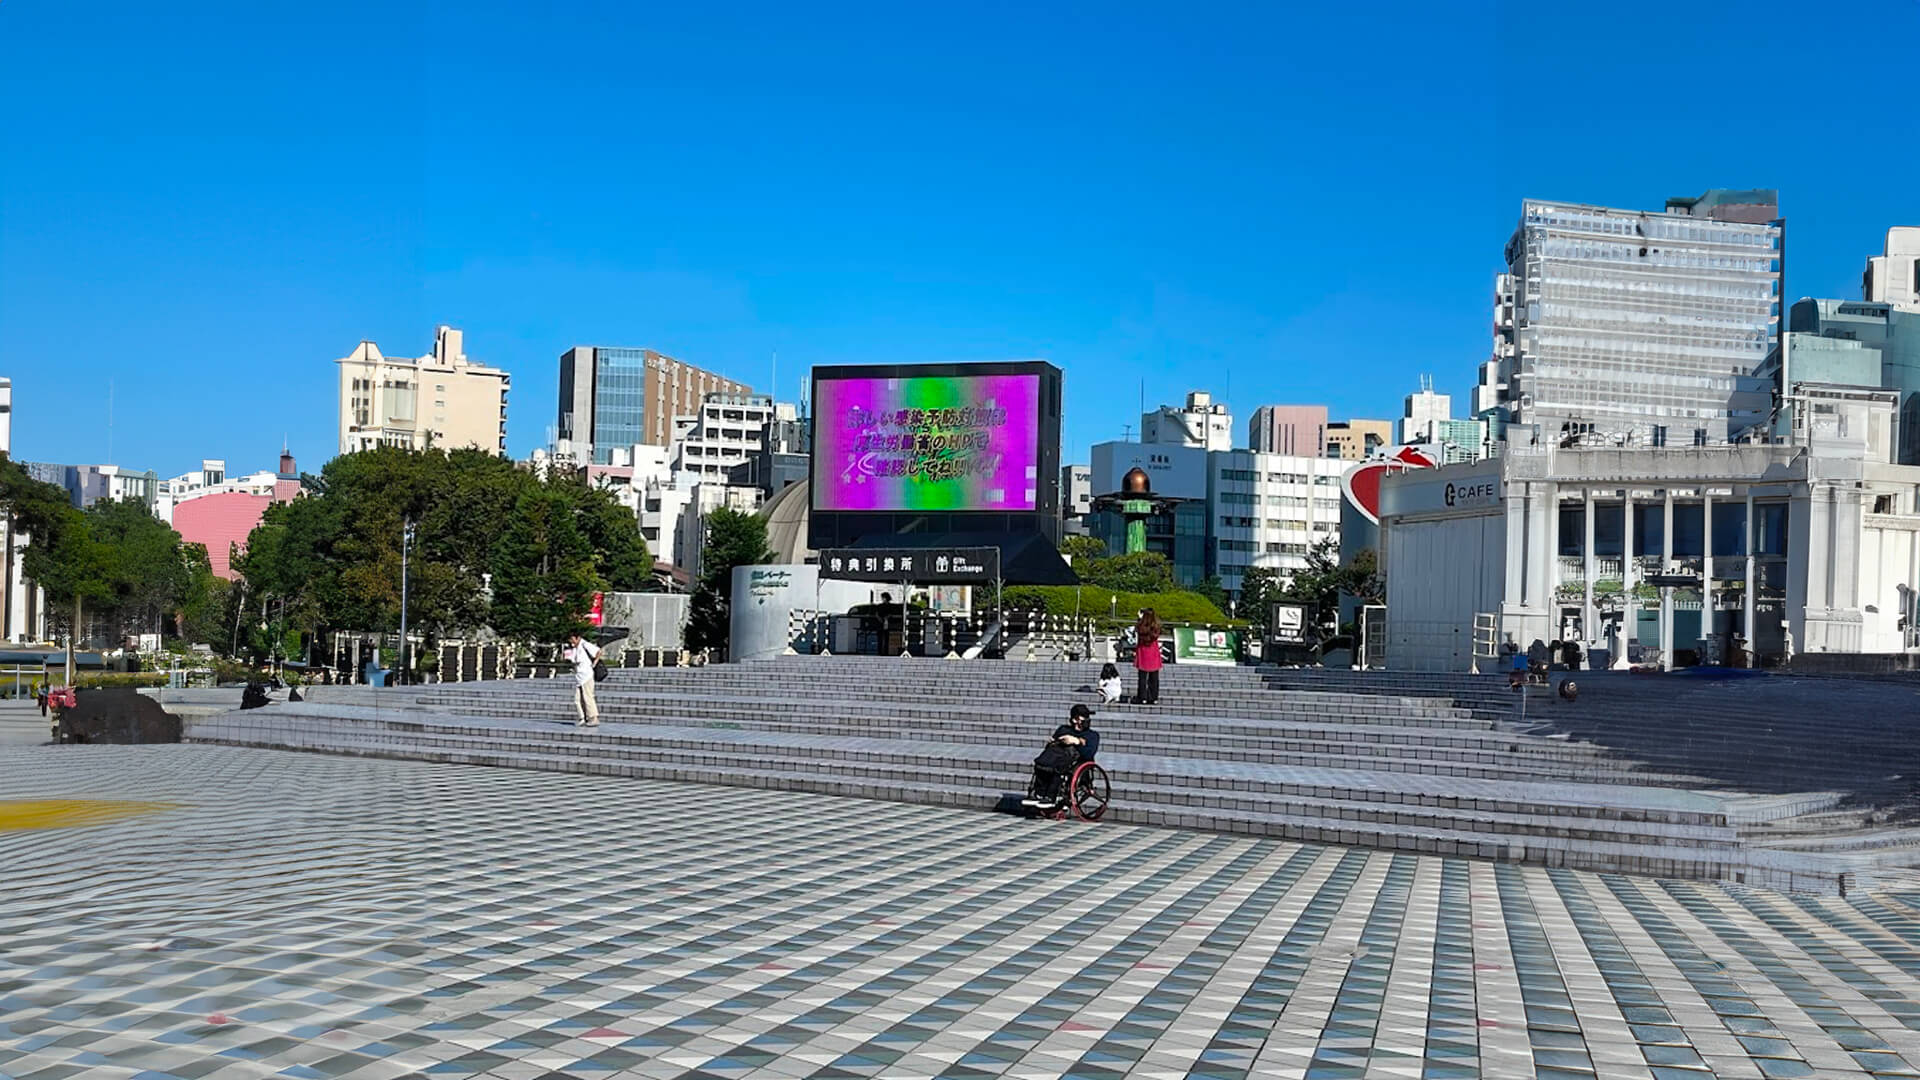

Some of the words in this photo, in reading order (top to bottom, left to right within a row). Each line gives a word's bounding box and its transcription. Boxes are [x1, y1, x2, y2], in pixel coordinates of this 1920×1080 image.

[1458, 484, 1494, 499] CAFE
[830, 556, 913, 572] 特典引換所
